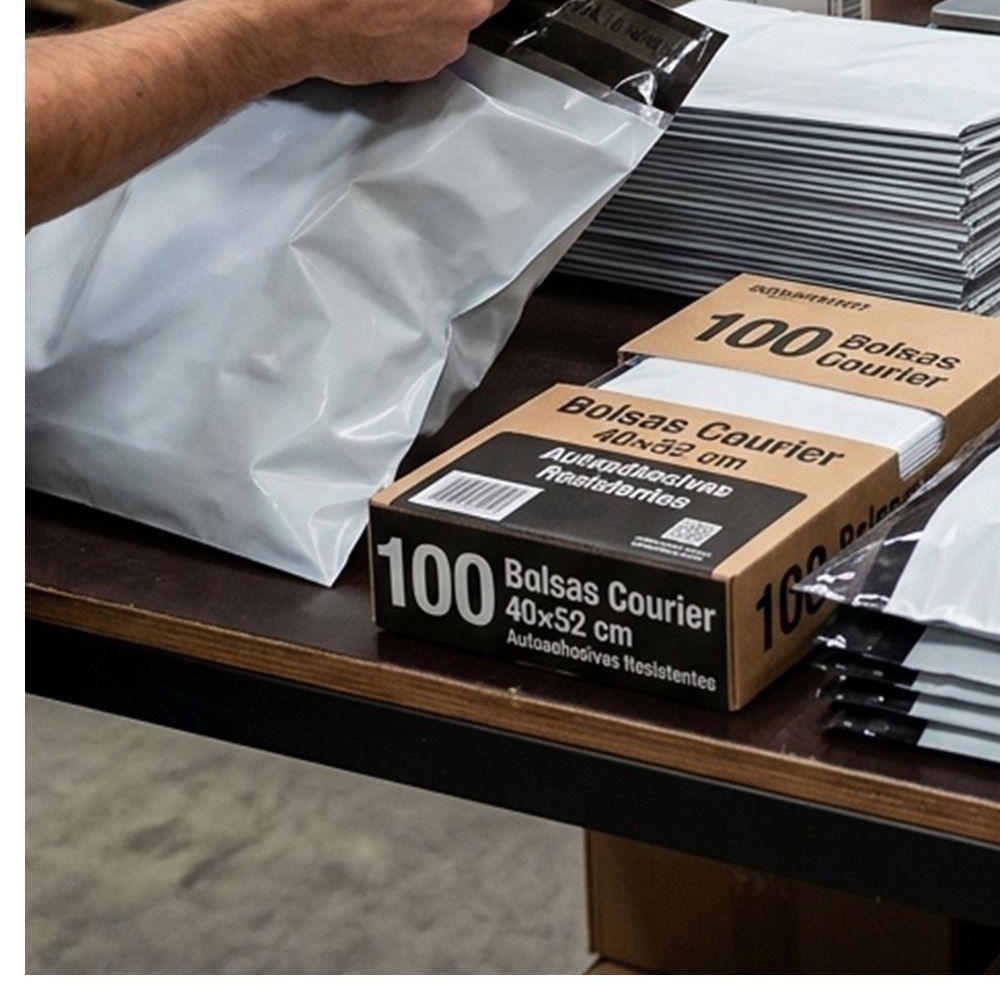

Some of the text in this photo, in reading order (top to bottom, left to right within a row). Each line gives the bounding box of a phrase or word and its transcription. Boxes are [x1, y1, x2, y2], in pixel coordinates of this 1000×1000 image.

[694, 312, 962, 371] 100 Bolsas
[815, 351, 950, 389] Courier
[556, 395, 847, 467] Bolsas Courier
[377, 536, 496, 627] 100
[608, 580, 717, 632] Courier
[505, 596, 633, 648] 40x52 cm
